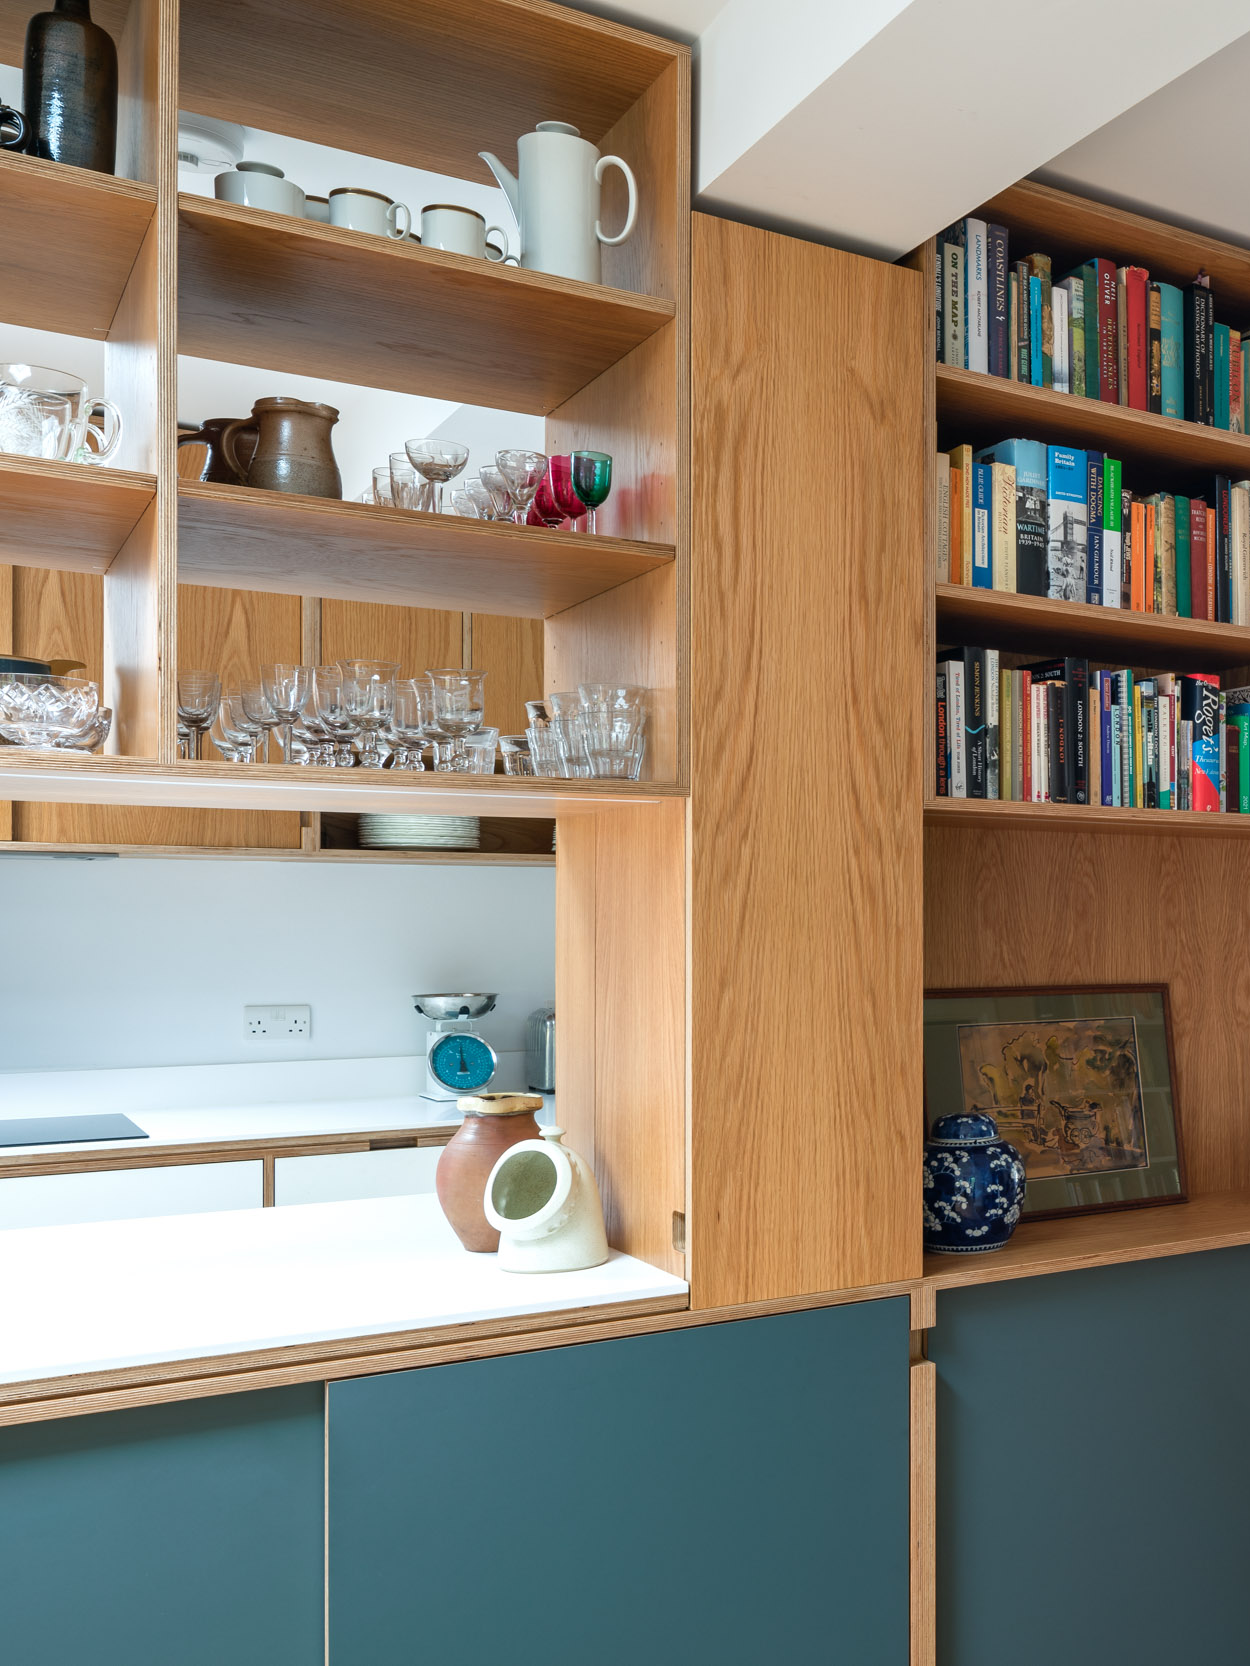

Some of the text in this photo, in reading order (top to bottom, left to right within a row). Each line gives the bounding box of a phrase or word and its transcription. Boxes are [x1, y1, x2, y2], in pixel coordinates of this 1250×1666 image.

[951, 253, 959, 328] ON THE MAP
[996, 240, 1005, 311] COASTLINES
[1054, 452, 1075, 461] Family
[1054, 458, 1075, 466] Britain
[1002, 474, 1015, 535] Victorian
[938, 701, 946, 737] London
[1194, 688, 1219, 754] Roget's
[938, 738, 947, 768] through
[939, 777, 947, 794] lens
